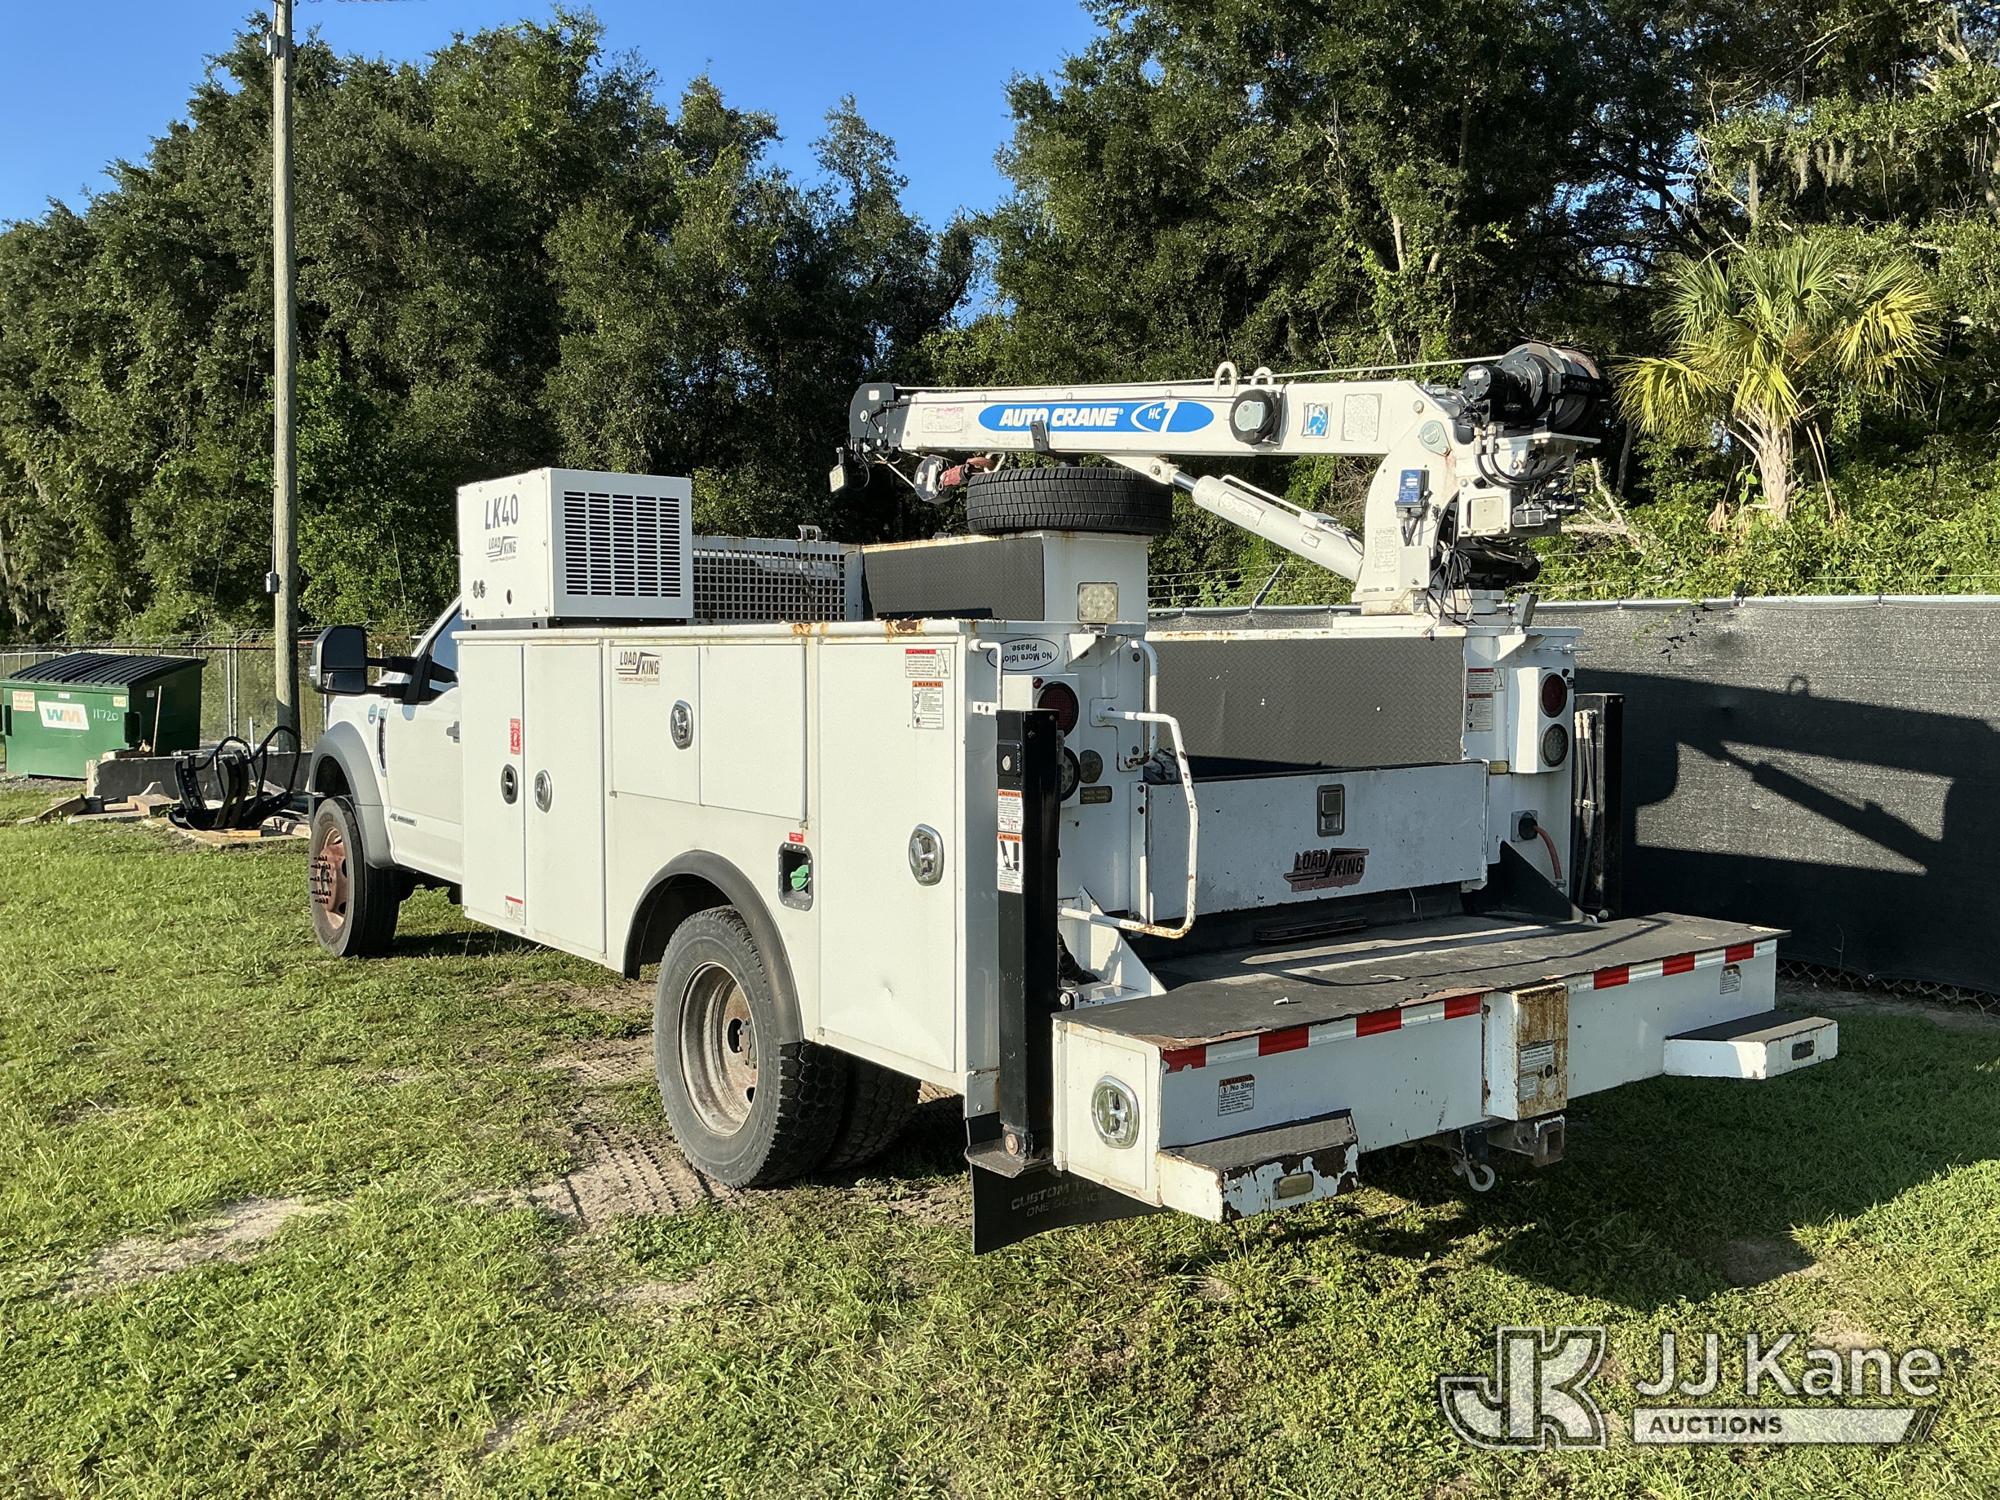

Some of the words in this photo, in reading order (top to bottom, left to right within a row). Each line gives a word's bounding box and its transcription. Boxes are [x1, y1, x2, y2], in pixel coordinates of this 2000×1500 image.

[999, 408, 1049, 427] AUTO
[1051, 408, 1121, 427] CRANE
[1147, 407, 1162, 420] HC
[1159, 400, 1179, 433] 7
[485, 493, 519, 531] LK40
[619, 651, 637, 666] LOAD
[1020, 652, 1040, 661] More
[1041, 651, 1053, 660] No
[641, 660, 660, 675] KING
[45, 708, 82, 724] WM
[1294, 849, 1329, 871] LOAD
[1334, 856, 1364, 877] KING
[1230, 1084, 1240, 1092] No
[1011, 1184, 1070, 1211] CUSTOM
[1026, 1204, 1049, 1217] ONE
